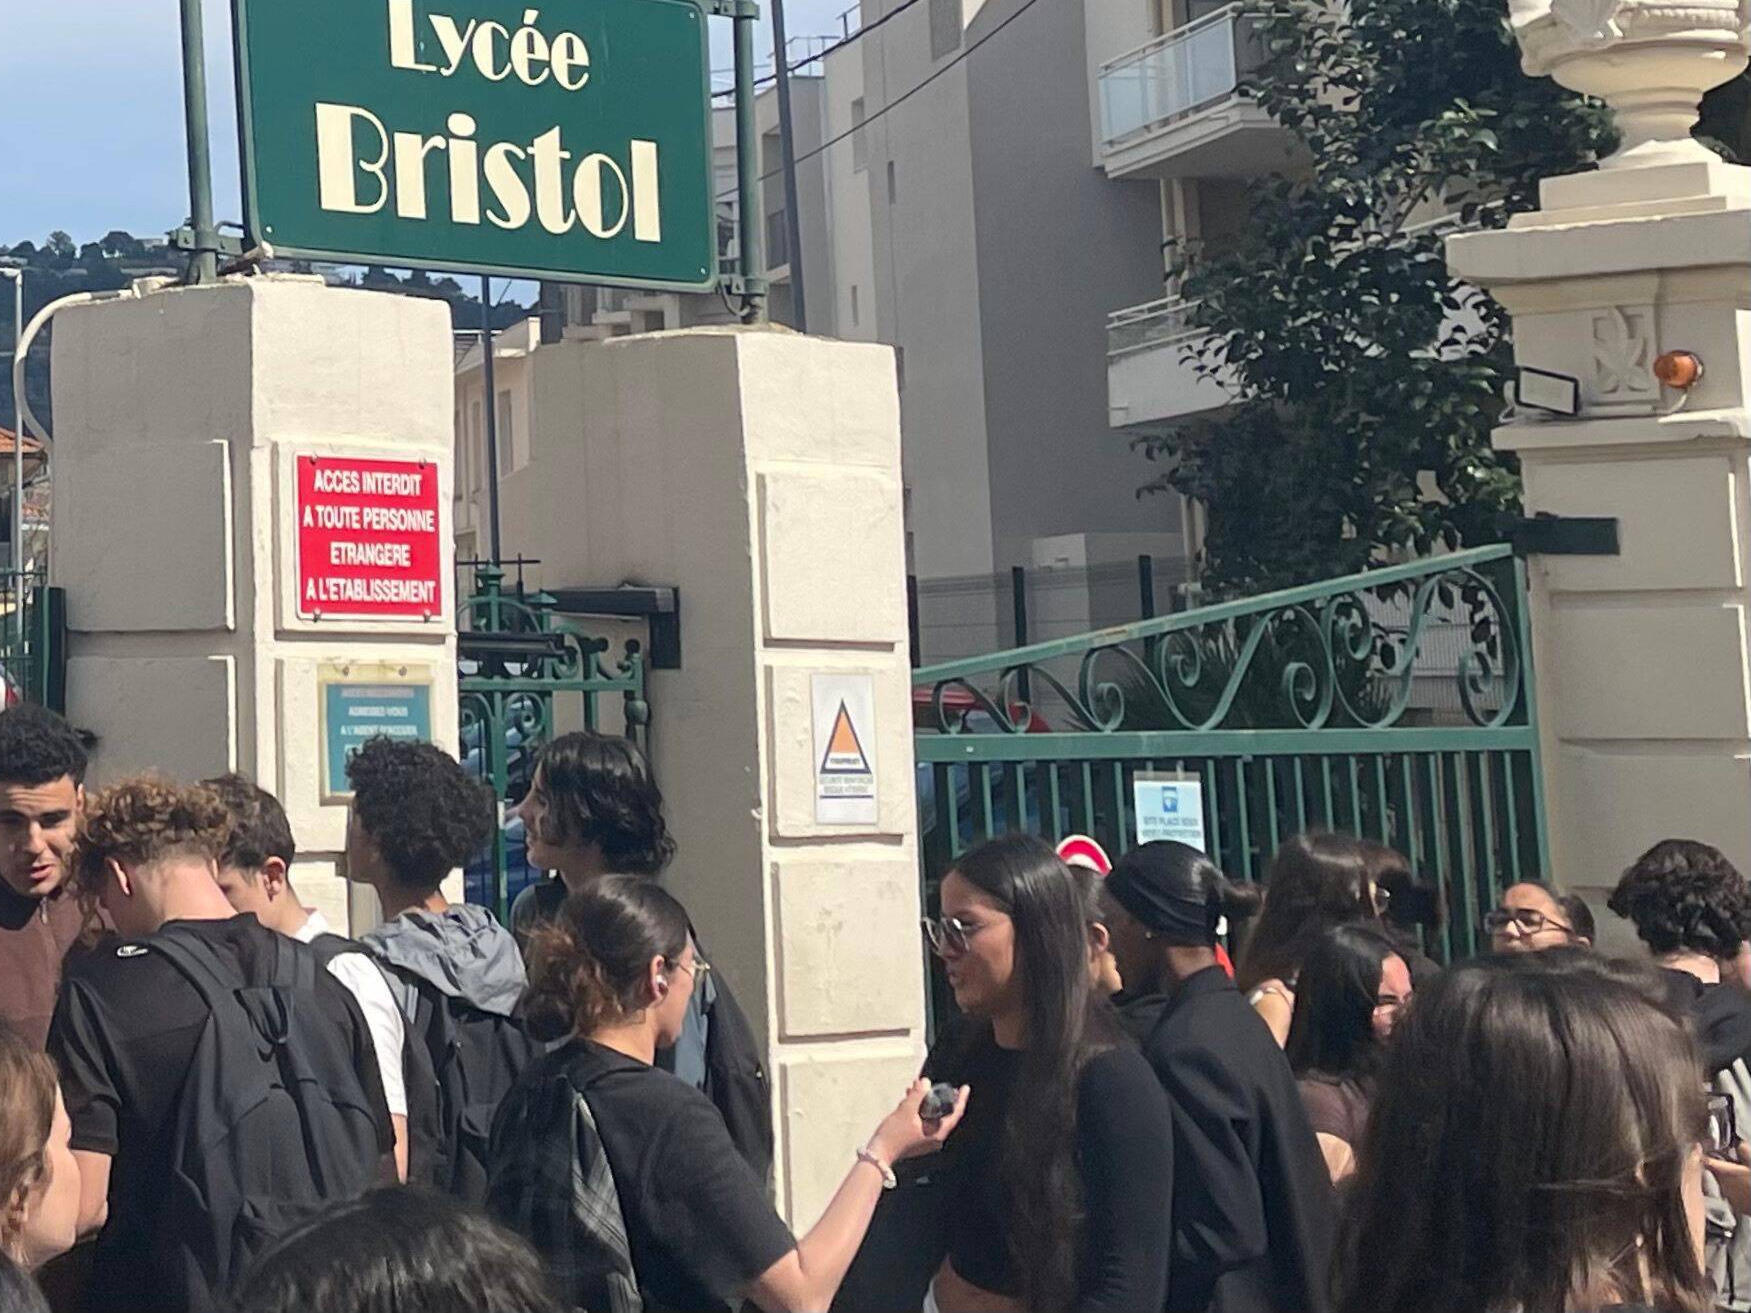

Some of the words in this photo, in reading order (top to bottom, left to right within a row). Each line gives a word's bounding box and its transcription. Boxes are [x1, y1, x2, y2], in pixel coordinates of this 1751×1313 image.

[315, 102, 661, 243] Bristol
[314, 470, 360, 493] ACCES
[362, 471, 422, 496] INTERDIT
[303, 505, 314, 527] A
[315, 506, 360, 529] TOUTE
[363, 507, 436, 532] PERSONNE
[330, 542, 411, 567] ETRANGERE
[305, 577, 316, 600] A
[319, 577, 436, 603] L'ETABLISSEMENT
